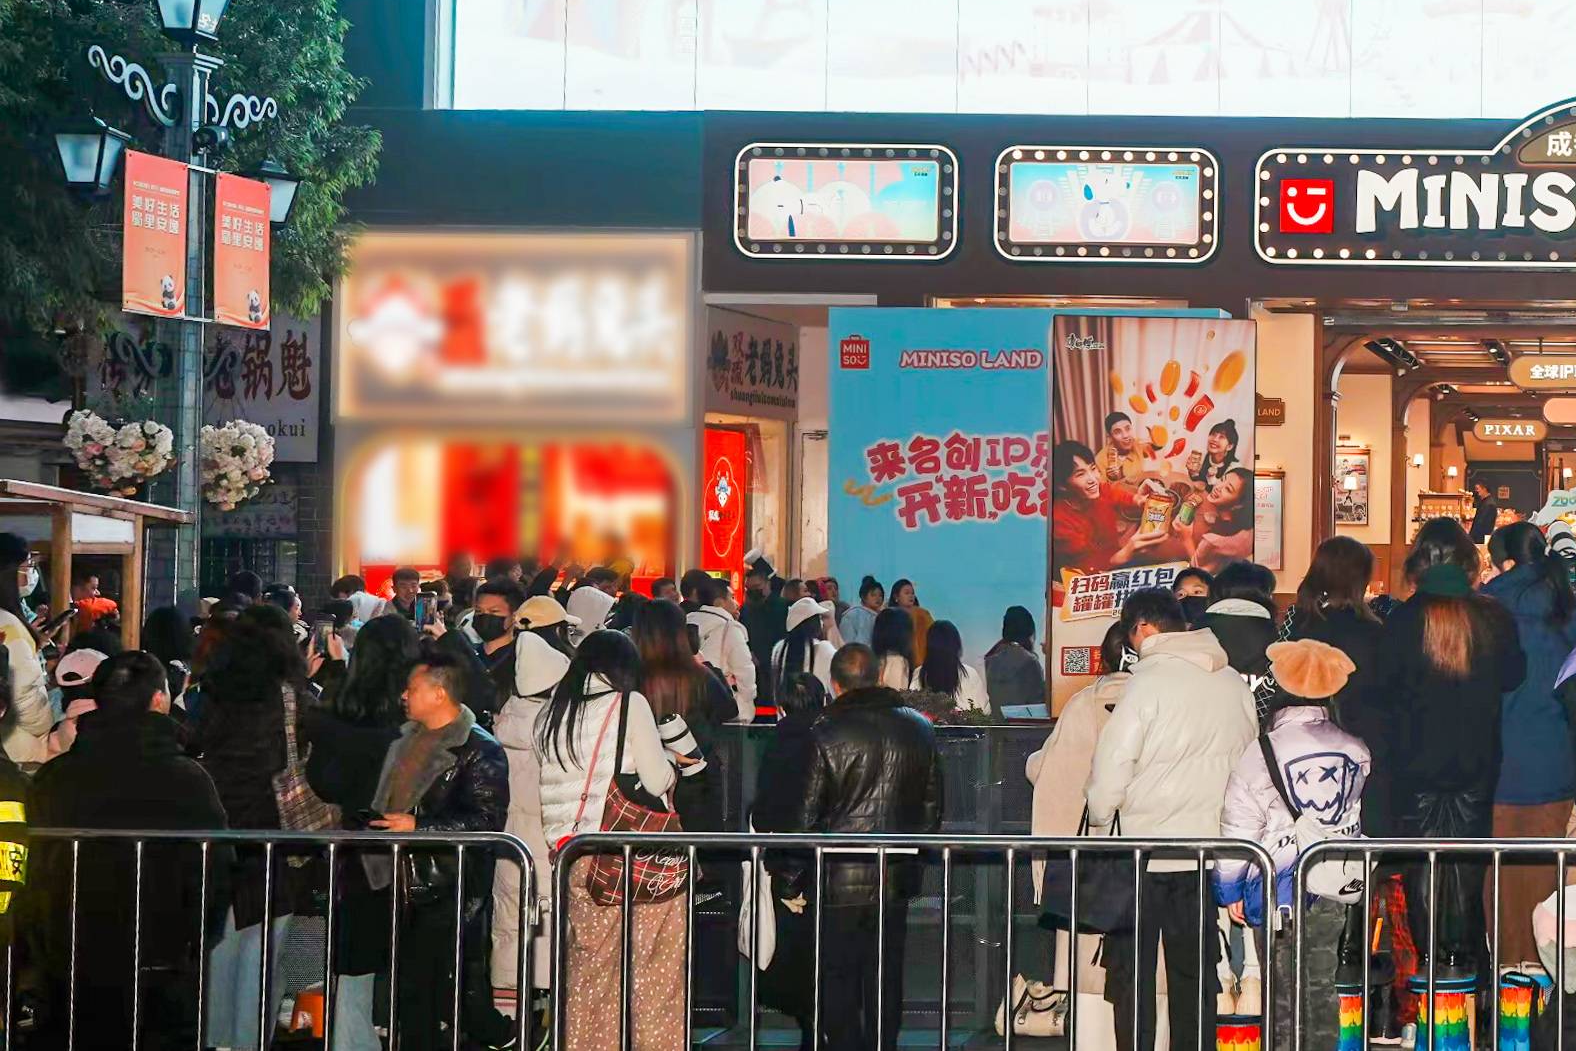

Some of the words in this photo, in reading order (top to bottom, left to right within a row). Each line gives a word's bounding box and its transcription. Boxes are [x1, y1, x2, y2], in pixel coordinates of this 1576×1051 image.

[843, 344, 867, 354] MINI
[900, 350, 977, 369] MINISO
[980, 350, 1042, 369] LAND
[1257, 408, 1281, 417] LAND
[1484, 424, 1536, 436] PIXAR
[1071, 568, 1175, 595] 扫码赢红包
